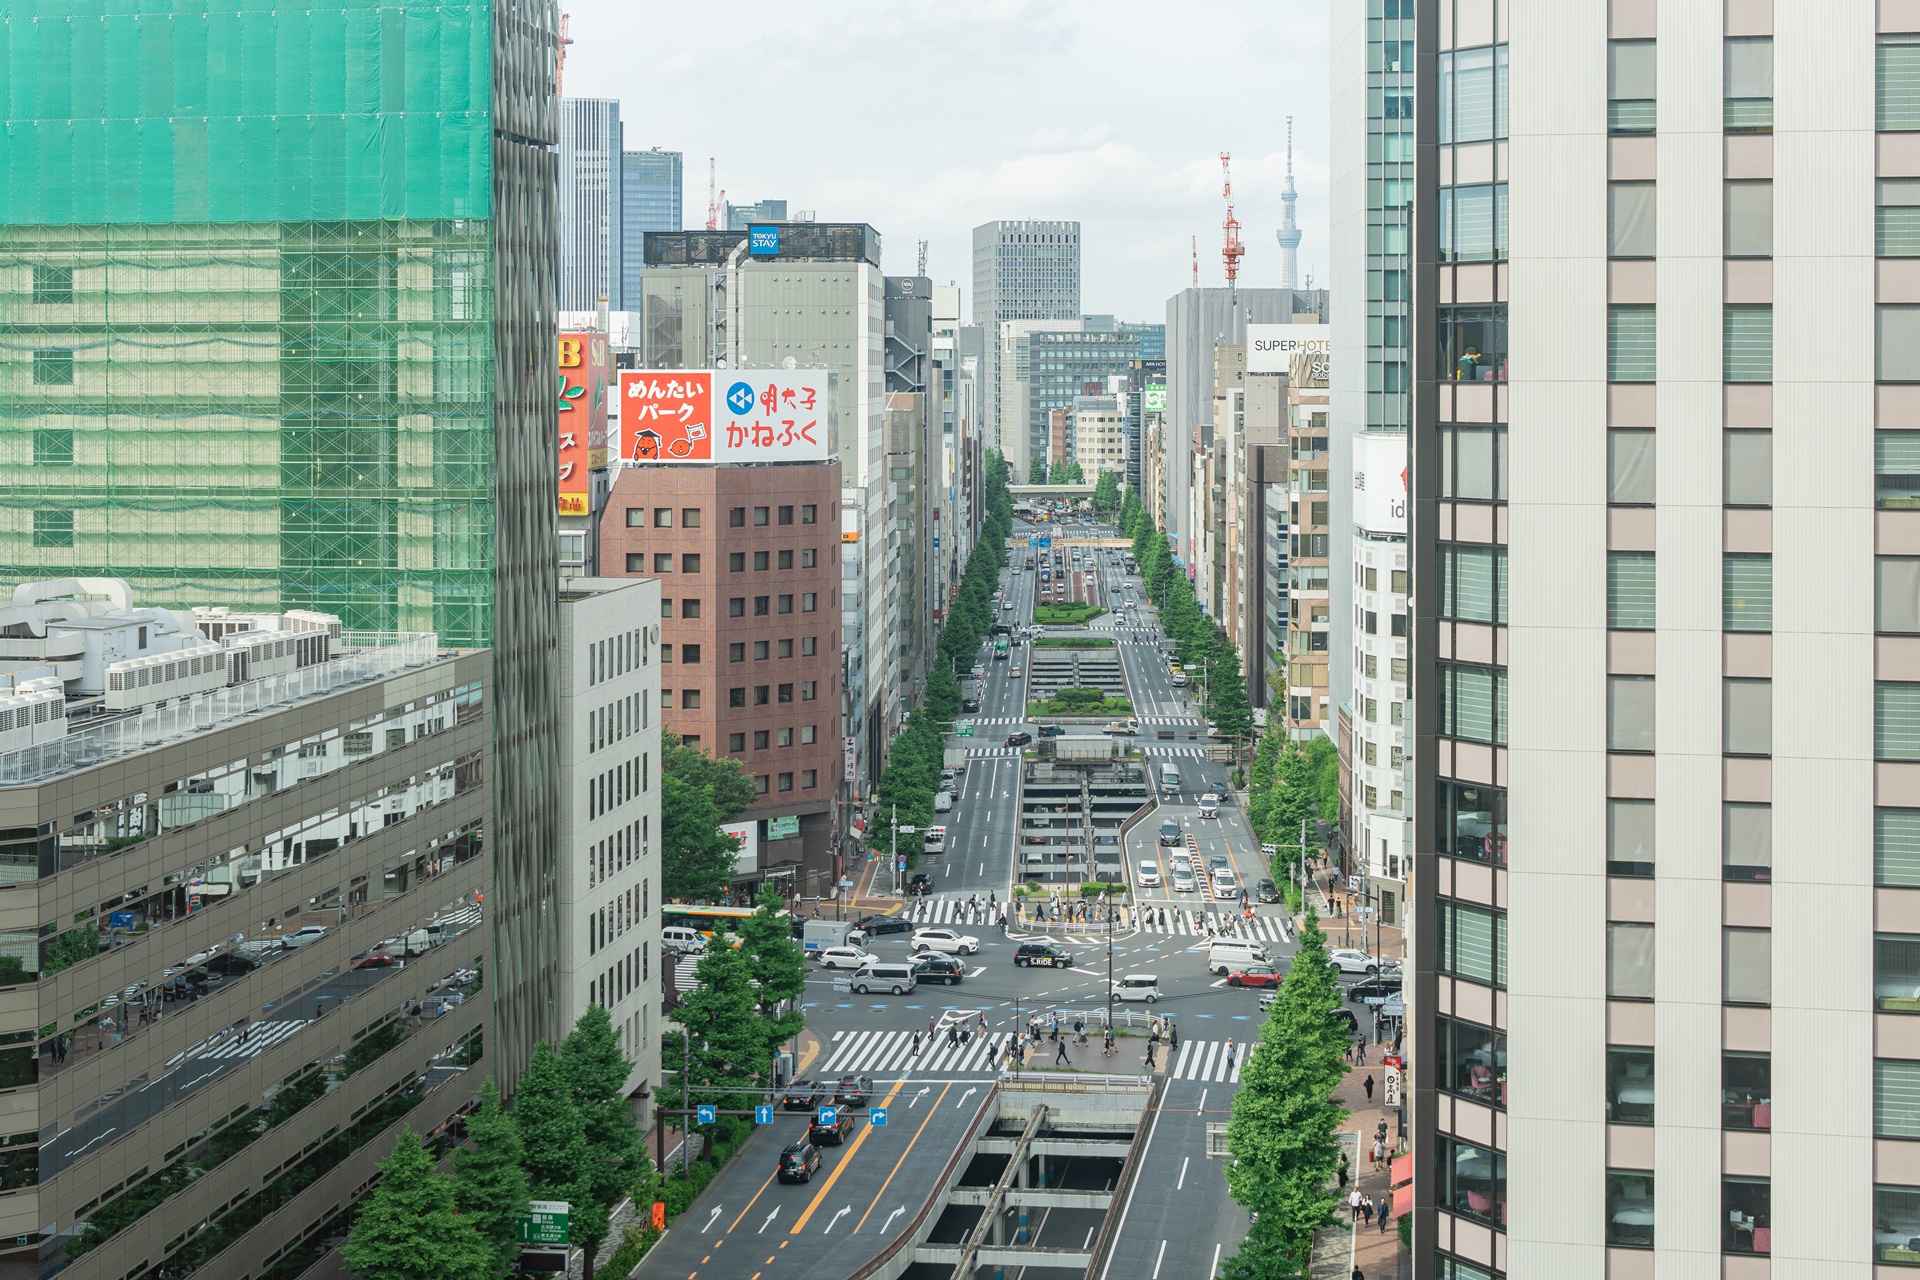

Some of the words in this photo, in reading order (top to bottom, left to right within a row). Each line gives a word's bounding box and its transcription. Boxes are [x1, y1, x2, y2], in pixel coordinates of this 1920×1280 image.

[752, 239, 777, 248] STAY
[591, 338, 605, 367] S&B
[628, 379, 704, 399] めんたい
[759, 383, 818, 416] 明太子
[638, 402, 695, 422] パーク
[726, 419, 818, 448] かねふく
[1390, 498, 1405, 519] id
